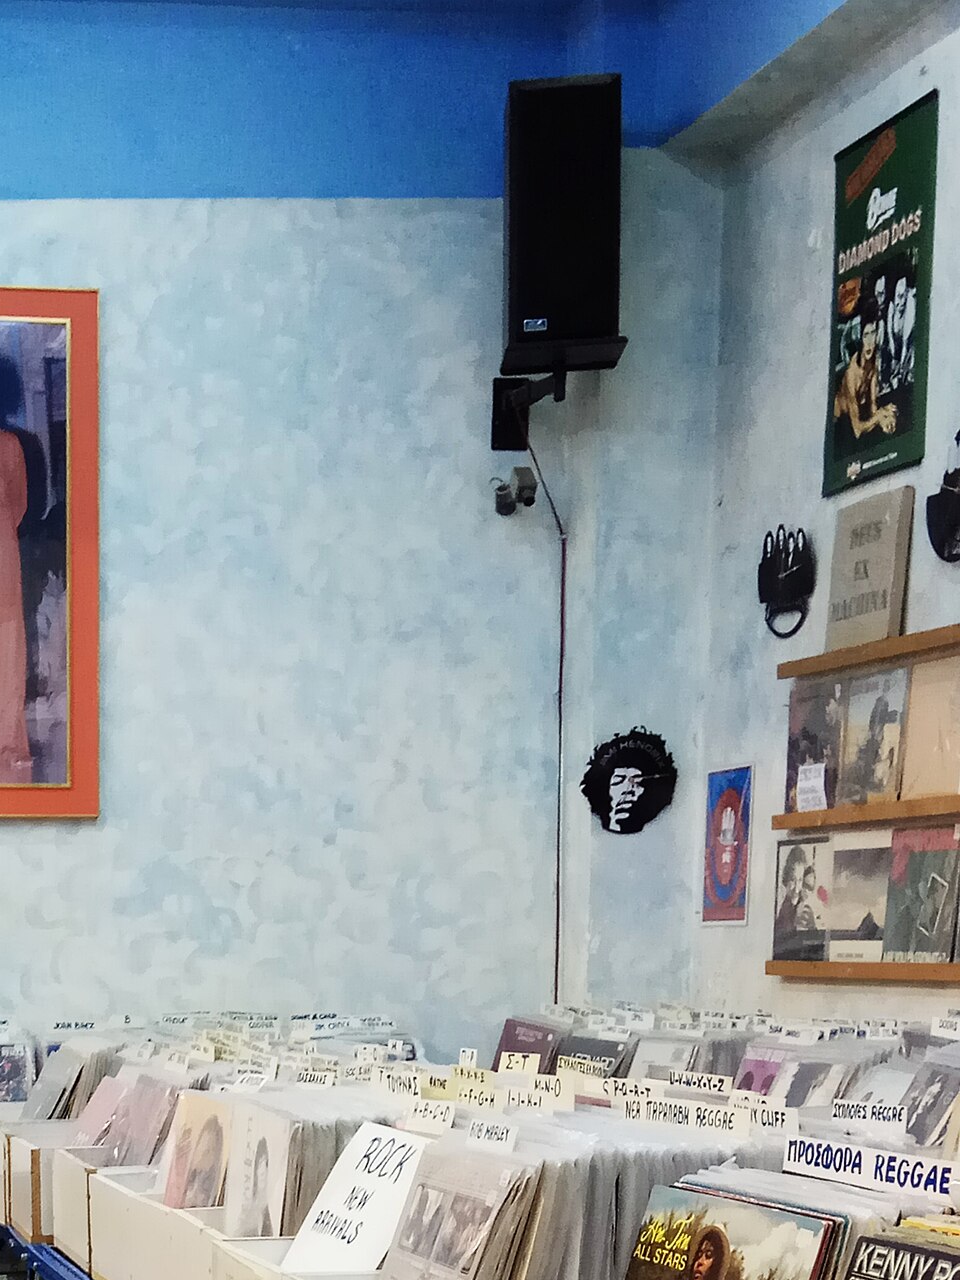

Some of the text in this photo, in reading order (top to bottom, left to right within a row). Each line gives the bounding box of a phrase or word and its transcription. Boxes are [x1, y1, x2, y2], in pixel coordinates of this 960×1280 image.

[838, 206, 922, 274] DIAMOND DOGS
[355, 1136, 418, 1185] ROCK
[787, 1139, 952, 1195] ΠΡΟΣΦΟΡΑ REGGAE
[343, 1186, 376, 1212] NEW
[310, 1209, 364, 1245] ARRIVALS
[633, 1243, 689, 1271] ALL STARS
